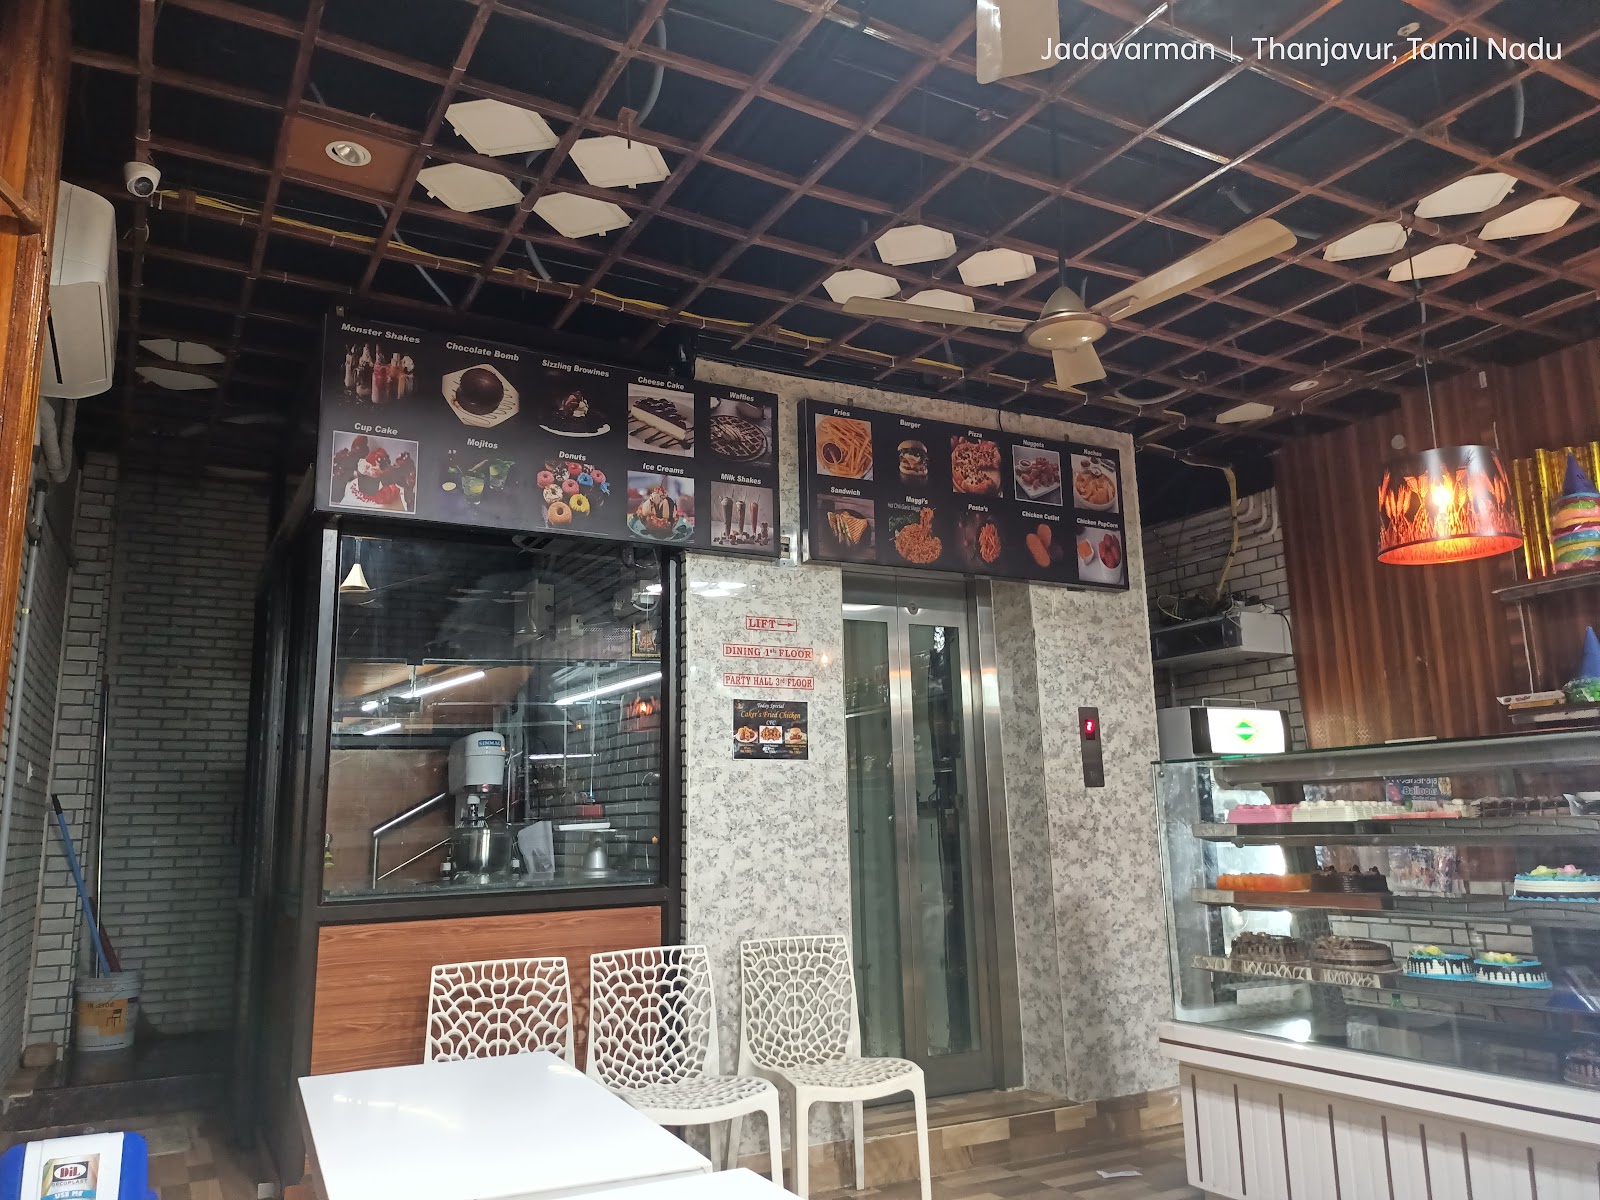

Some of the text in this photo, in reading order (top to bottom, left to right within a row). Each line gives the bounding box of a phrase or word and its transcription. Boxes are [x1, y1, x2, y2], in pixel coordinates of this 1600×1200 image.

[341, 322, 421, 344] Monster Shakes
[446, 341, 520, 362] Chocolate Bomb
[542, 359, 610, 378] Sizzling Browines
[637, 376, 685, 391] Cheese Cake
[729, 391, 755, 402] Waffles
[833, 408, 851, 417] Fries
[354, 422, 399, 436] Cup Cake
[899, 419, 921, 429] Burger
[967, 430, 983, 439] Pizza
[467, 438, 499, 450] Mojitos
[1022, 439, 1045, 449] Nuggets
[558, 450, 587, 462] Donuts
[642, 462, 685, 475] Ice Creams
[720, 472, 762, 485] Milk Shakes
[830, 486, 861, 496] Sandwich
[905, 495, 929, 506] Maggi's
[967, 503, 989, 513] Pasta's
[1021, 510, 1060, 522] Chicken Cutlet
[1076, 517, 1119, 530] Chicken PopCorn
[748, 618, 777, 629] LIFT
[725, 646, 761, 656] DINING
[779, 648, 812, 659] FLOOR
[725, 675, 751, 685] PARTY
[753, 676, 774, 686] HALL
[787, 678, 813, 688] FLOOR
[763, 710, 778, 718] Fried
[778, 711, 801, 720] Chicken
[1402, 785, 1438, 796] Balloons
